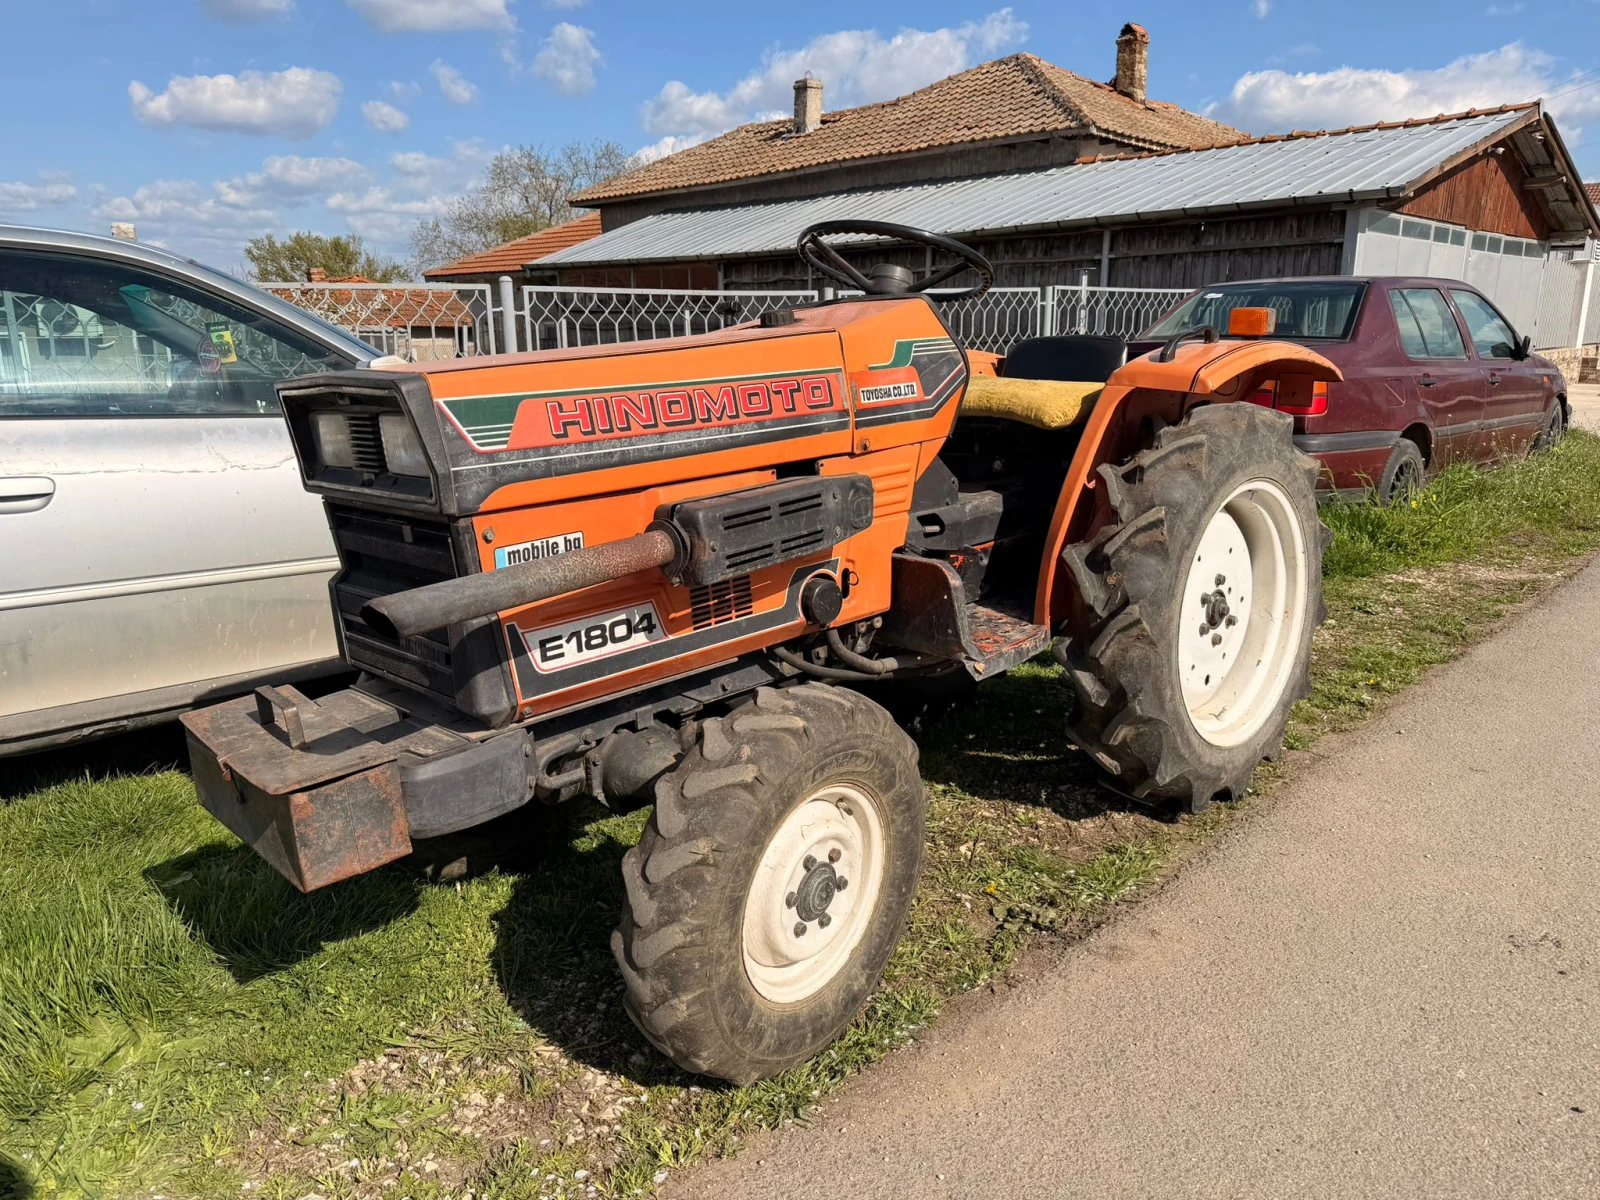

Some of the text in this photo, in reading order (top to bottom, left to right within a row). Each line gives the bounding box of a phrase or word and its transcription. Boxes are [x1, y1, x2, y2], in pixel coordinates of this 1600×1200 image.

[546, 377, 832, 438] HINOMOTO
[861, 386, 892, 402] TOYOSHA
[538, 612, 657, 663] E1804
